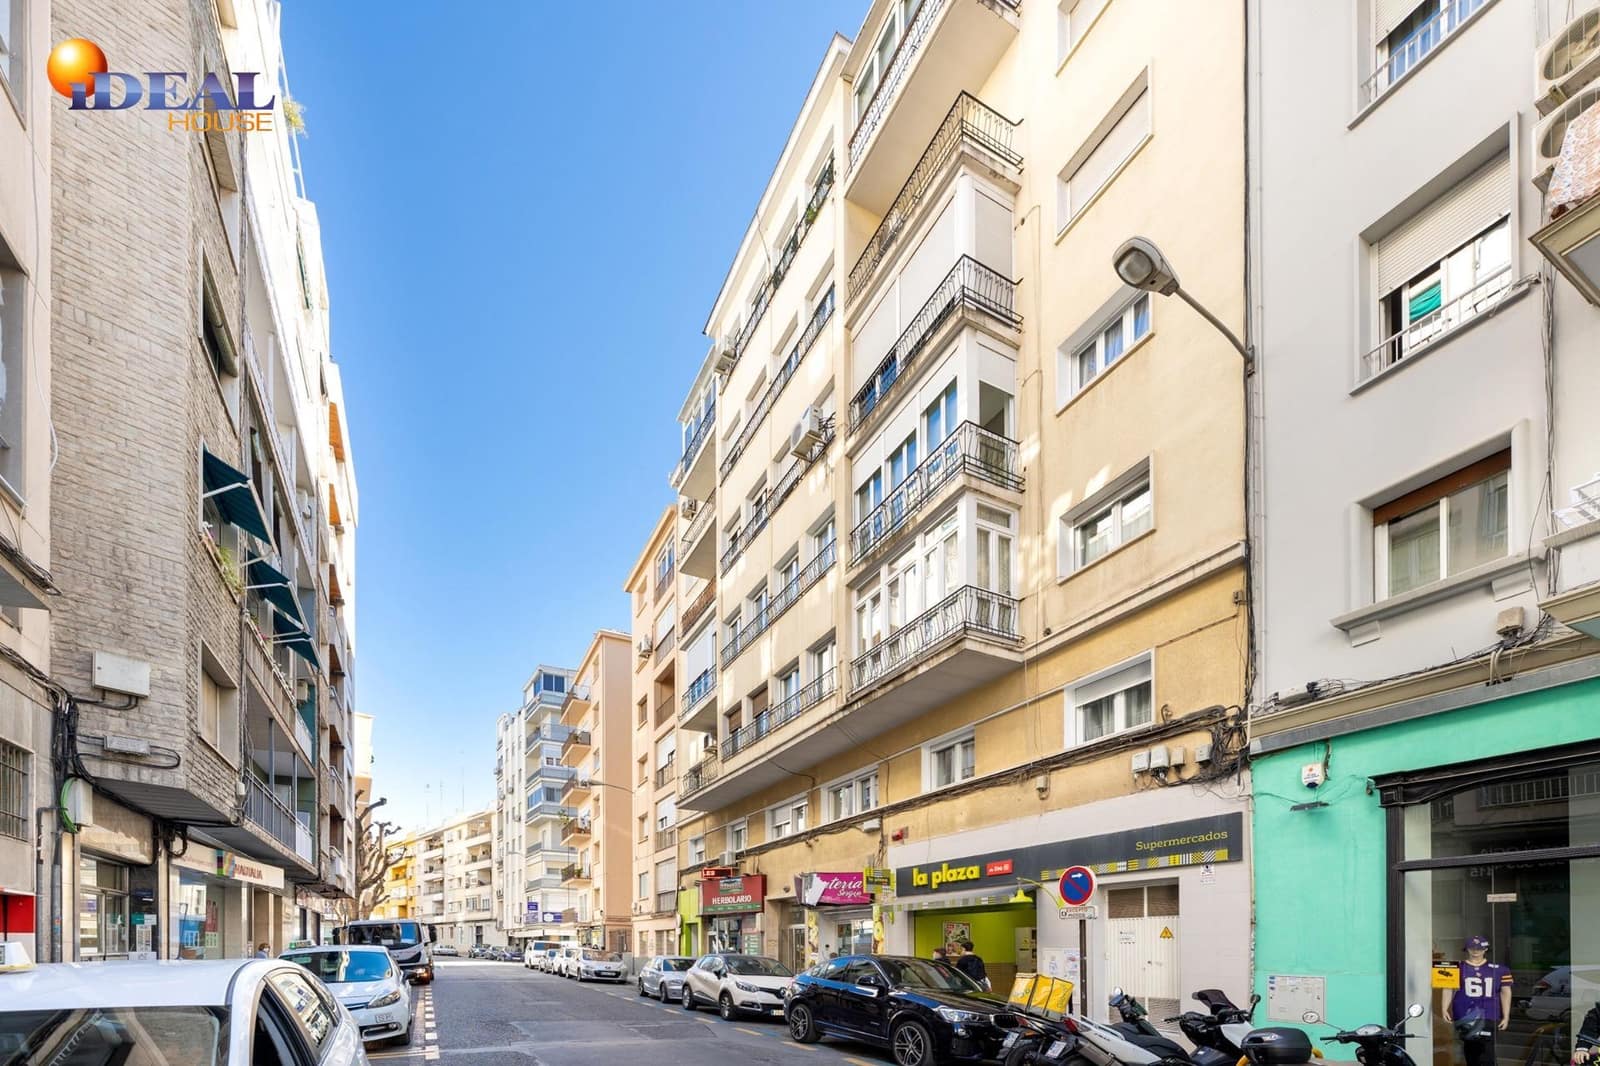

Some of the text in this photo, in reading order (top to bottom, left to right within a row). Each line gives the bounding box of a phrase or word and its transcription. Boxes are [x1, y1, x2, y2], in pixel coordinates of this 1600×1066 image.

[1135, 831, 1228, 851] Supermercados
[912, 863, 980, 889] la plaza
[712, 895, 752, 904] HERBOLARIO
[1465, 977, 1493, 998] 61
